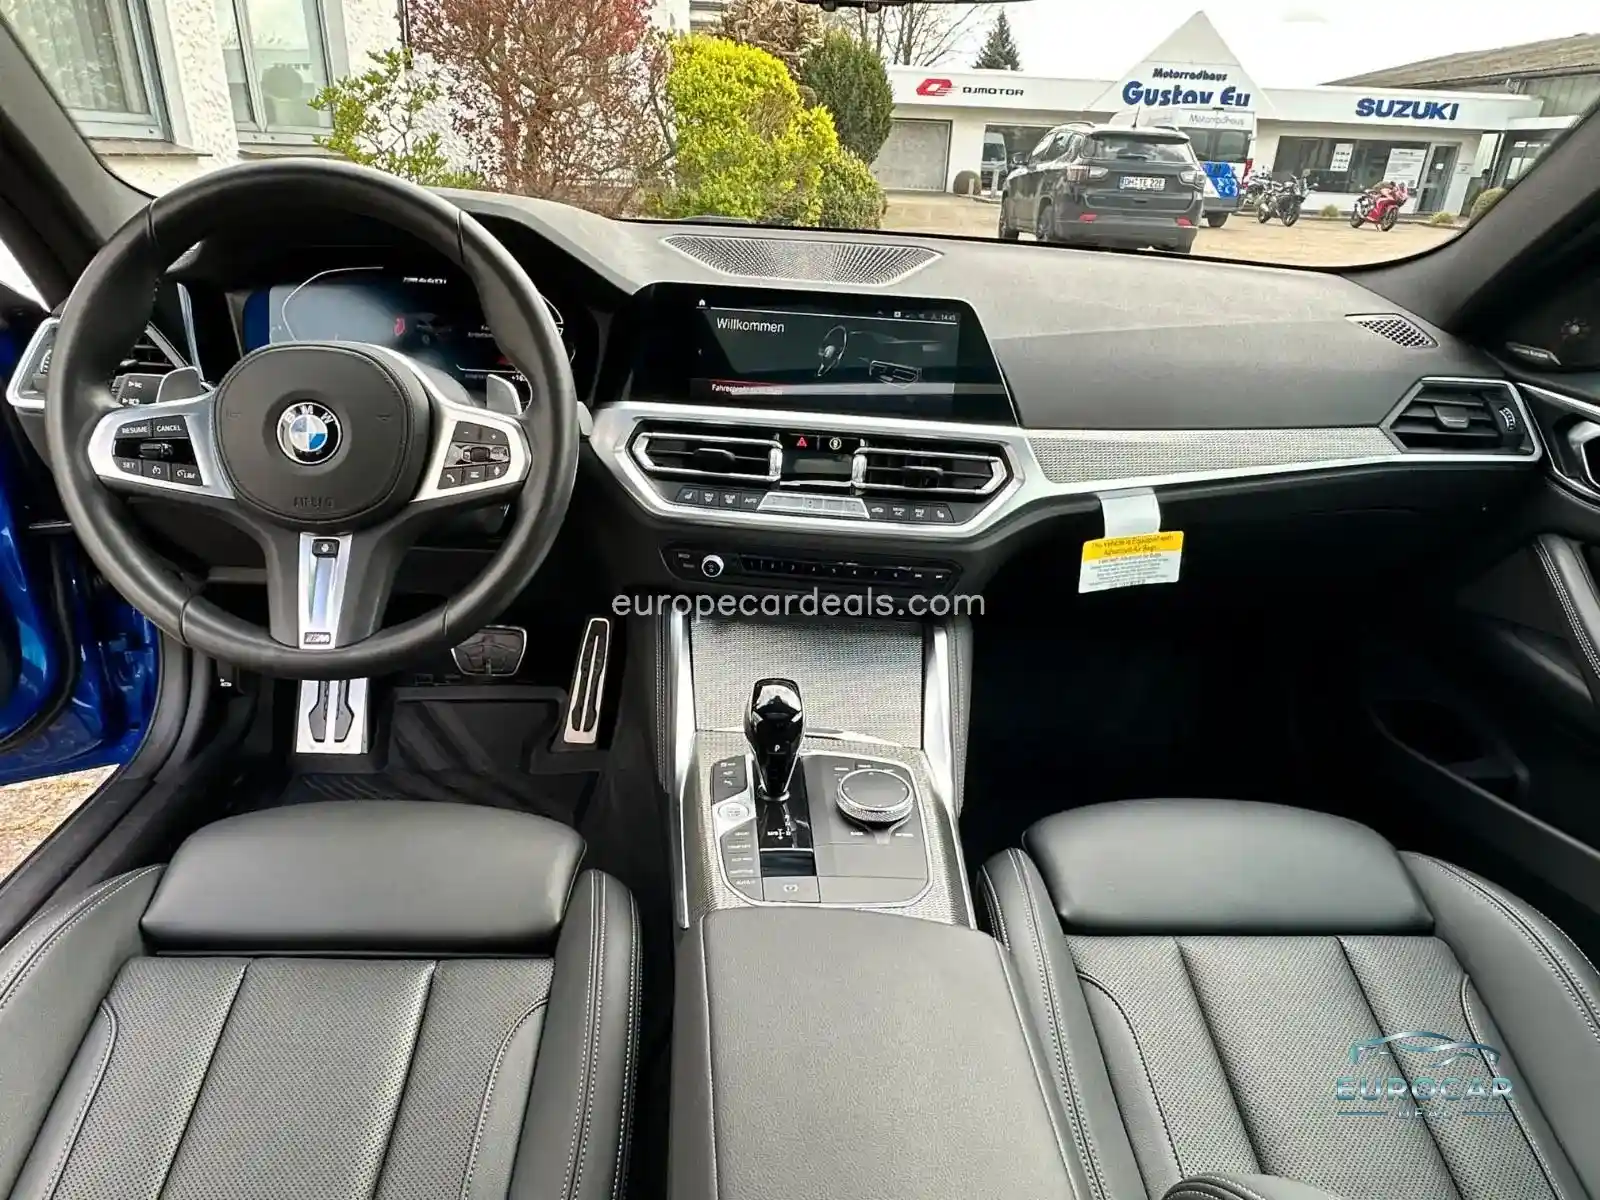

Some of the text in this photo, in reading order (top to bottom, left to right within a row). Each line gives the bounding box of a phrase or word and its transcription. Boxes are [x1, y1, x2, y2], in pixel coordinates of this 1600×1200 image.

[1152, 68, 1228, 81] Motorradhaus
[1122, 80, 1214, 106] Gustav
[1355, 98, 1459, 120] SUZUKI
[716, 317, 785, 333] Willkommen
[121, 426, 148, 434] RESUME
[156, 424, 182, 432] CANCEL
